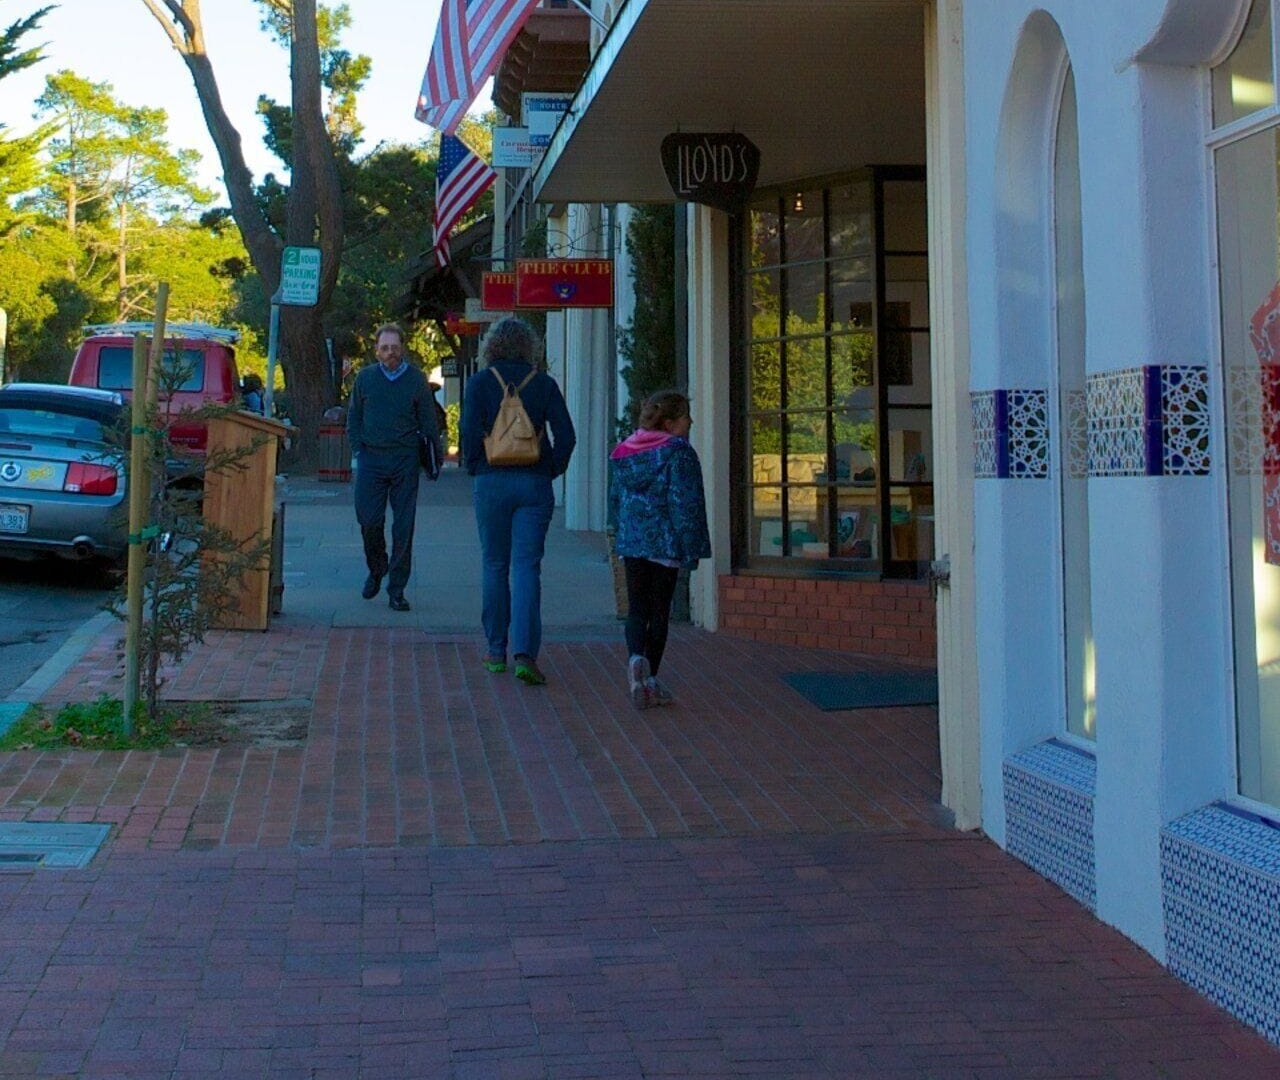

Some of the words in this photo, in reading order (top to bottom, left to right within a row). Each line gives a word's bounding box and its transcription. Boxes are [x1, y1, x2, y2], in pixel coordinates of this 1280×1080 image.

[678, 138, 748, 193] LLOYD'S
[287, 251, 297, 263] 2
[284, 268, 317, 280] PARKING
[521, 262, 558, 275] THE
[561, 262, 611, 275] CLUB
